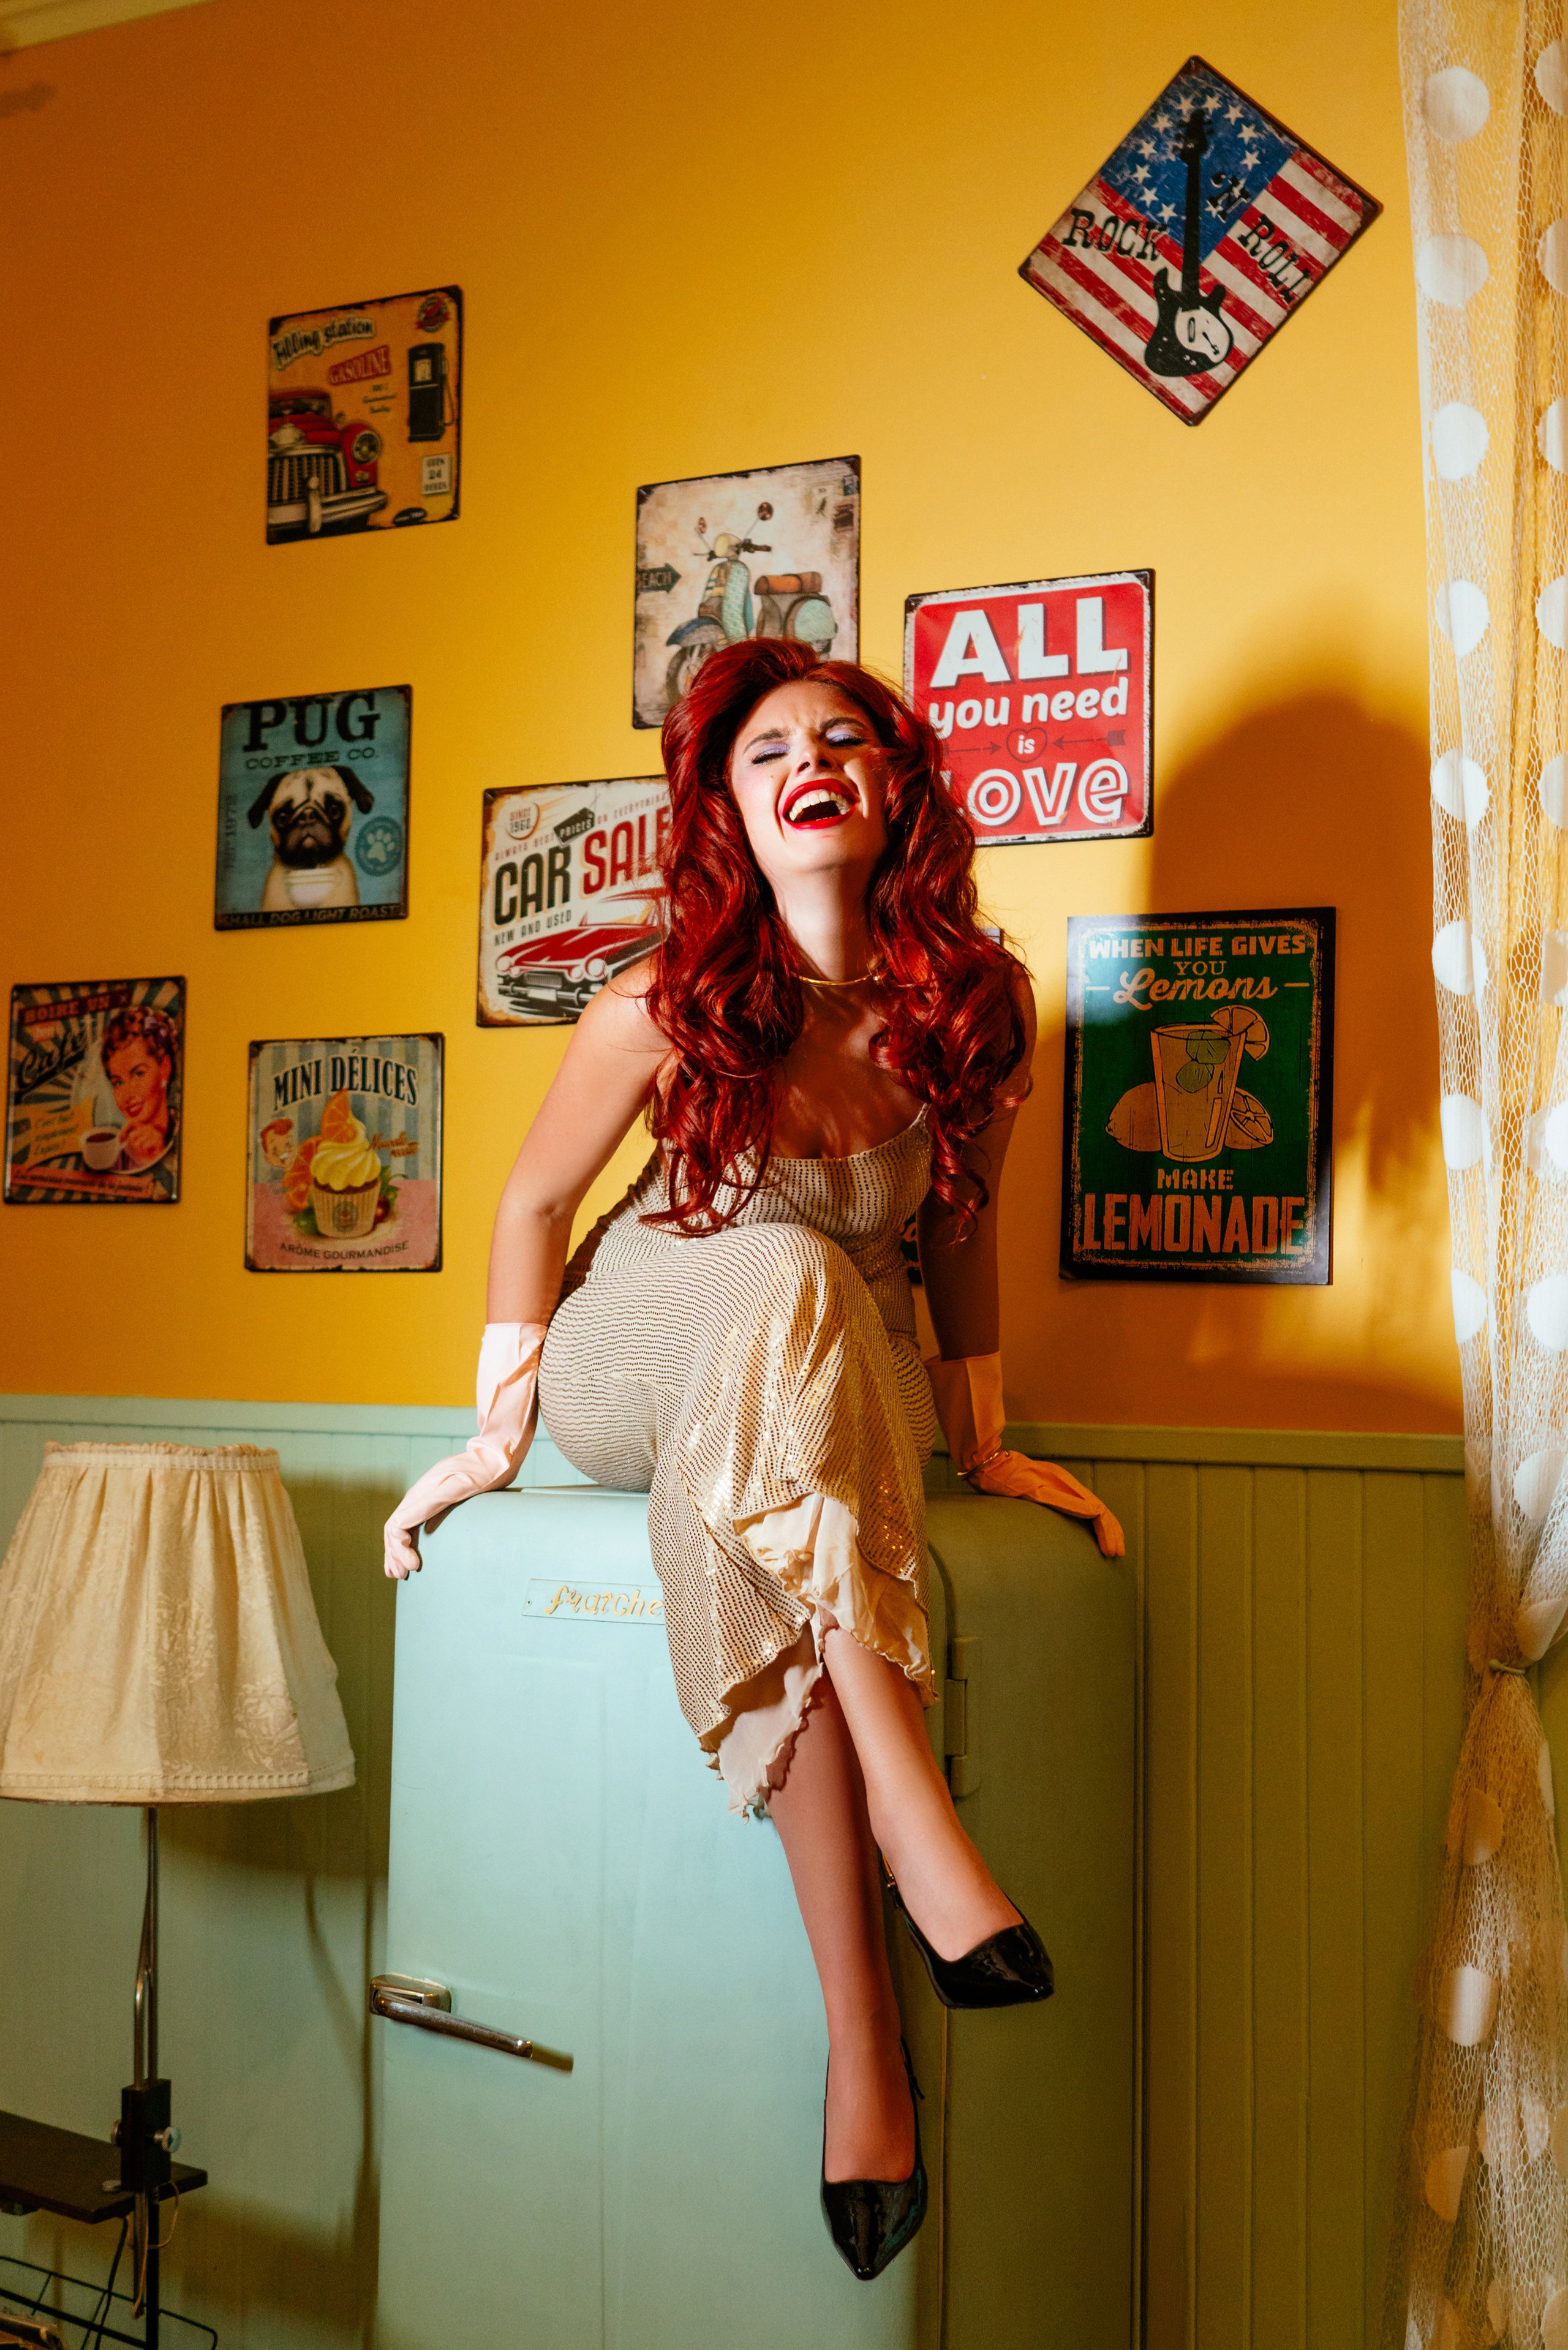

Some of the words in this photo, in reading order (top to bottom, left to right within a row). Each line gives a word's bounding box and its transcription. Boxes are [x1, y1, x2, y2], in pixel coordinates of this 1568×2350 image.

[1061, 208, 1170, 262] ROCK
[1237, 214, 1312, 306] ROLL
[330, 348, 388, 384] GASOLINE
[930, 596, 1129, 688] ALL
[243, 692, 381, 753] PUG
[929, 696, 1011, 739] you
[1022, 676, 1129, 725] need
[246, 750, 341, 770] COFFEE
[347, 747, 378, 761] CO.
[1017, 734, 1036, 754] is
[510, 807, 532, 820] SINCE
[558, 816, 592, 838] PRICES
[495, 845, 571, 926] CAR
[583, 804, 672, 895] SALE
[348, 903, 398, 918] ROAST
[494, 930, 515, 947] NEW
[521, 921, 541, 936] AND
[547, 909, 572, 930] USED
[1089, 938, 1164, 959] WHEN
[1170, 937, 1224, 957] LIFE
[1231, 935, 1306, 955] GIVES
[1172, 960, 1227, 976] YOU
[1112, 966, 1278, 1011] Lemons
[274, 1060, 323, 1111] MINI
[331, 1047, 417, 1106] DÉLICES
[1156, 1169, 1234, 1190] MAKE
[1082, 1192, 1307, 1254] LEMONADE
[280, 1241, 322, 1260] ARÔME
[323, 1240, 409, 1260] GOURMANDISE
